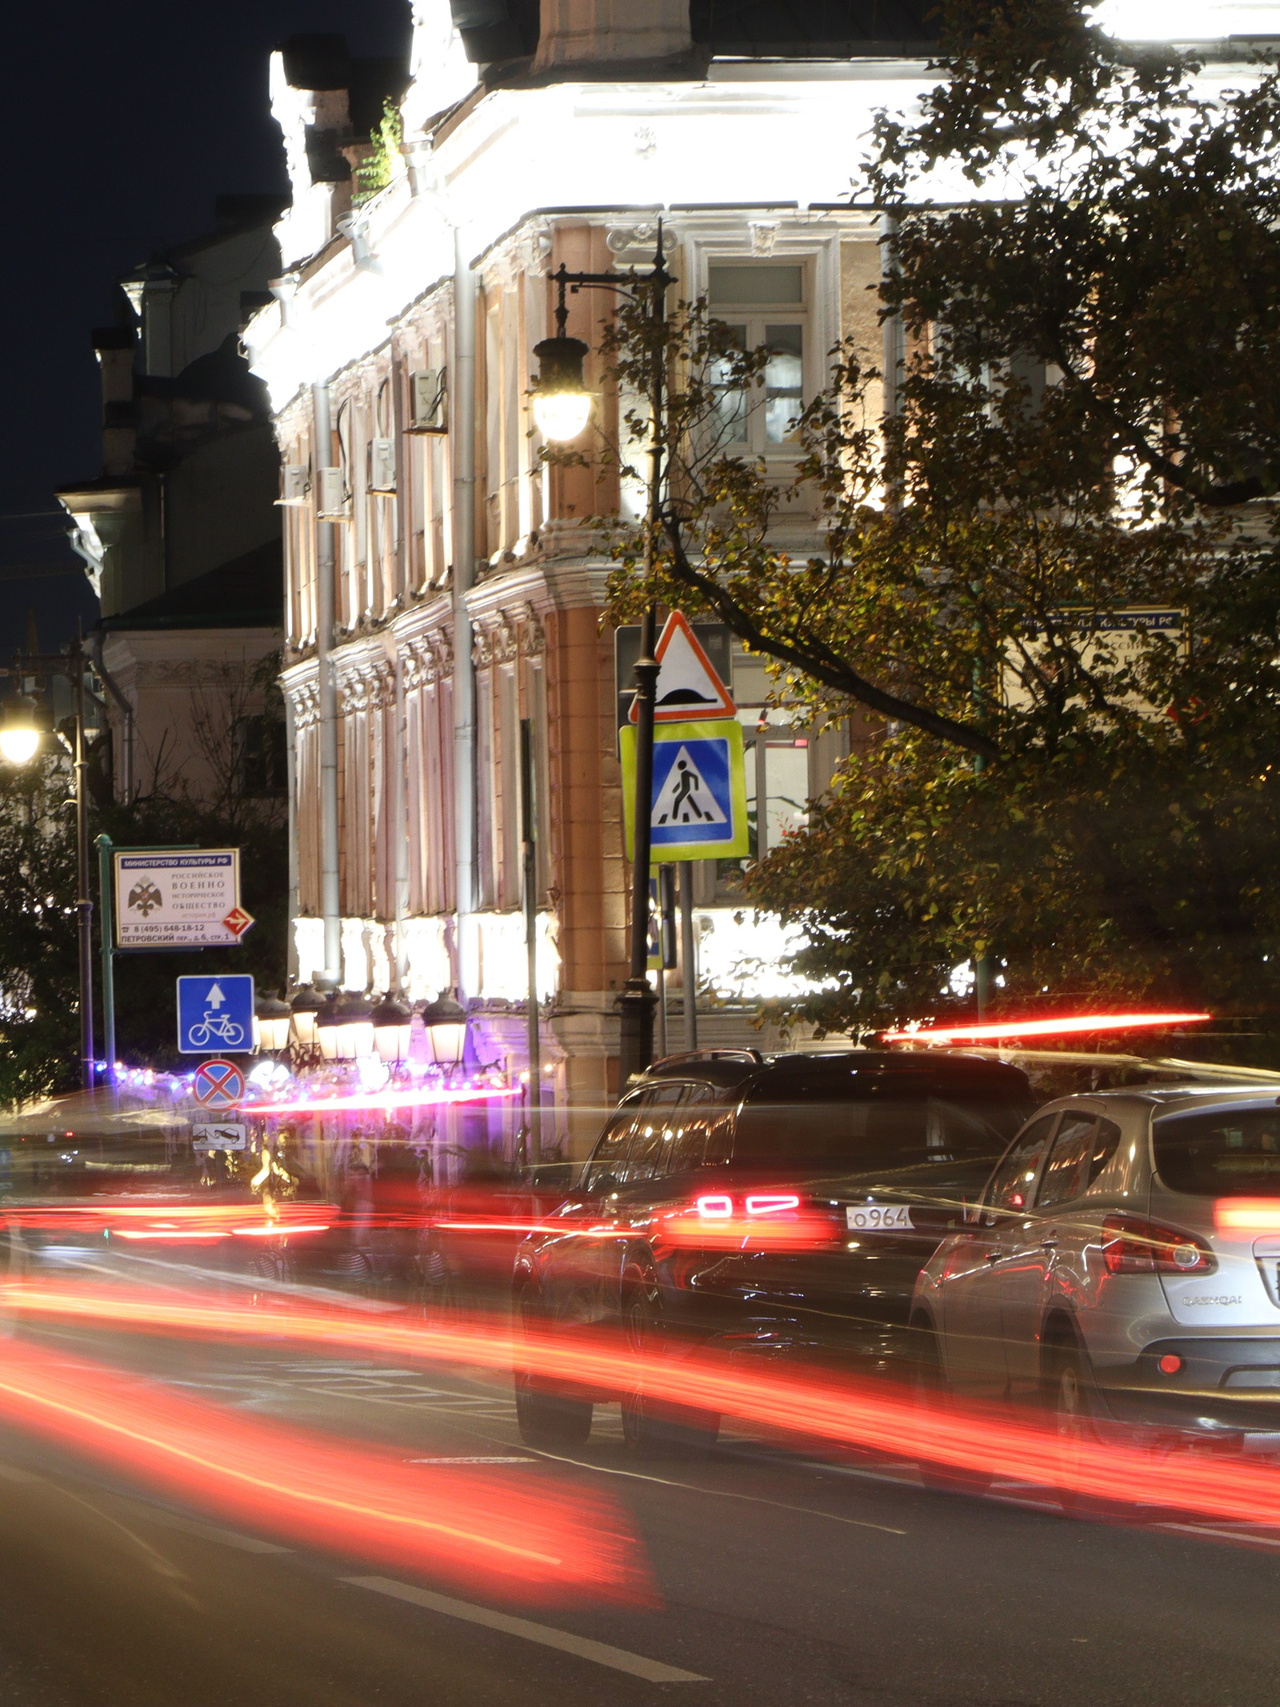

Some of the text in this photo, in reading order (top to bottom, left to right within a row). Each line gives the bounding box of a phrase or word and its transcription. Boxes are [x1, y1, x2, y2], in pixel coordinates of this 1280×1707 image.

[124, 856, 229, 867] МИНИСТЕРСТВО КУЛЬТУРЫ РФ
[171, 871, 224, 879] РОССИЙСКОЕ
[172, 880, 225, 890] ВОЕННО
[171, 891, 225, 899] ИСТОРИЧЕСКОЕ
[172, 901, 226, 910] ОБЩЕСТВО
[133, 923, 205, 934] 8 (495) 648-18-12
[121, 933, 175, 943] ПЕТРОВСКИЙ
